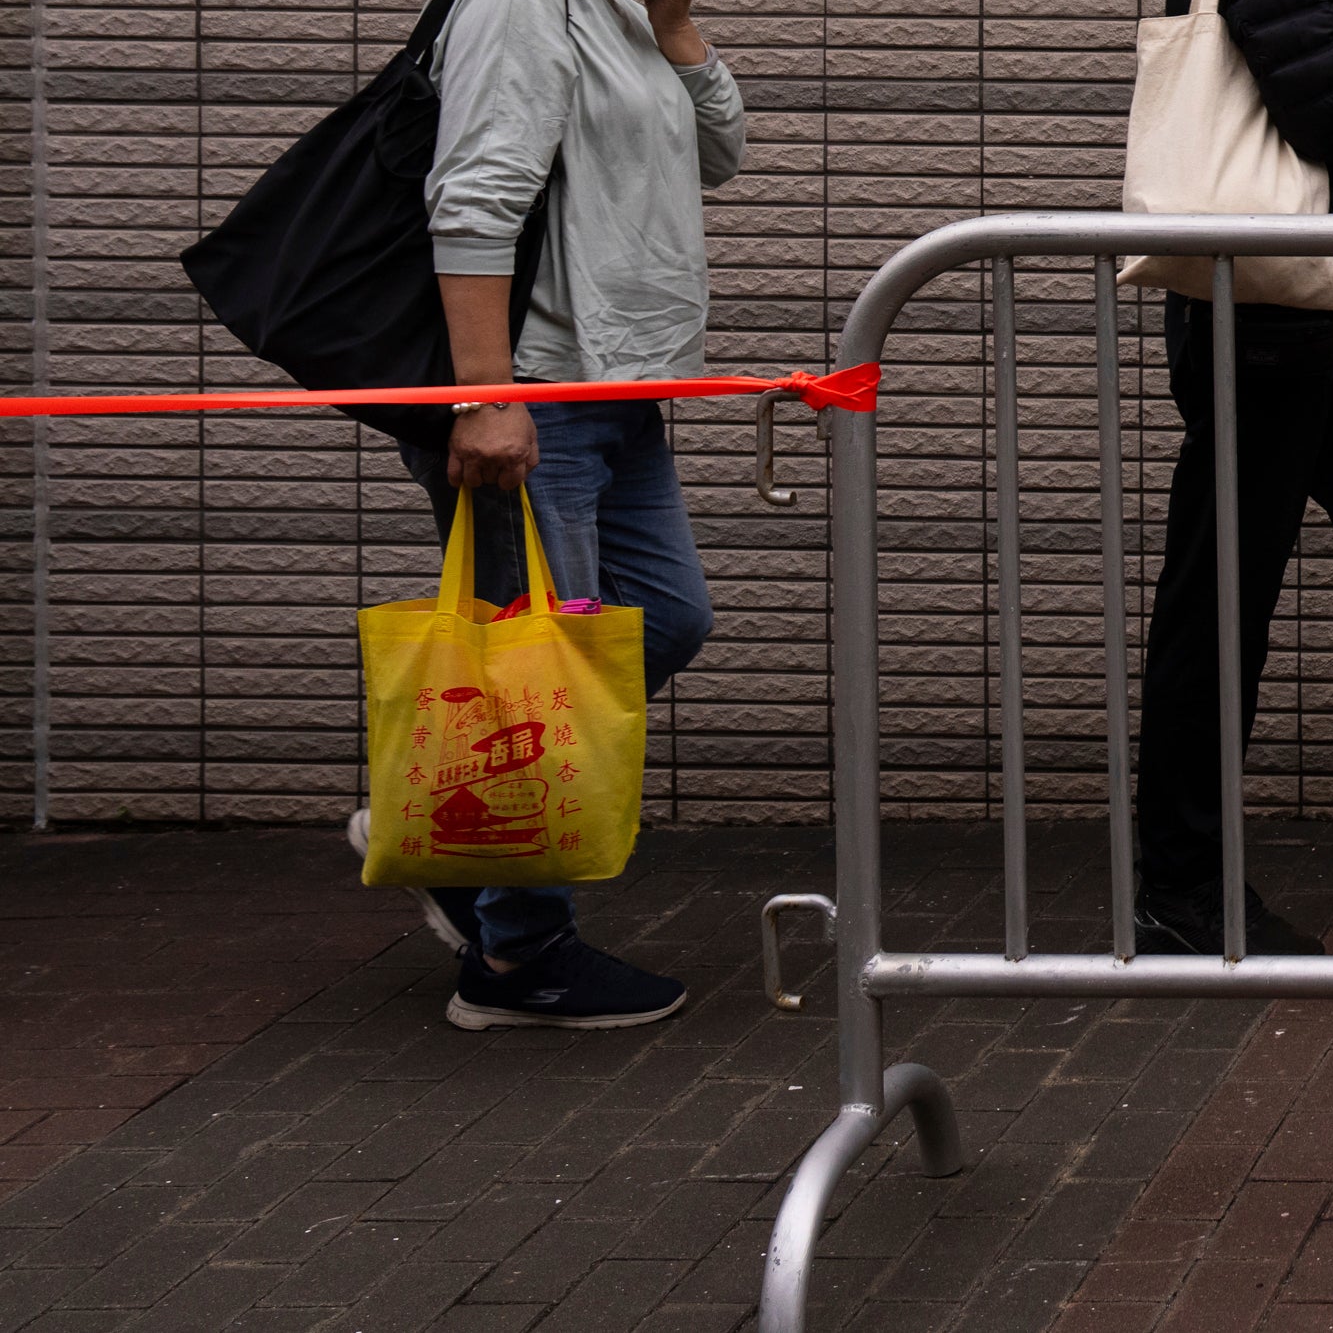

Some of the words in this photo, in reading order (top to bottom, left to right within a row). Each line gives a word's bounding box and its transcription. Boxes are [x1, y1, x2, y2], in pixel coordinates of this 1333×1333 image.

[551, 686, 583, 852] 炭燒杏仁餅
